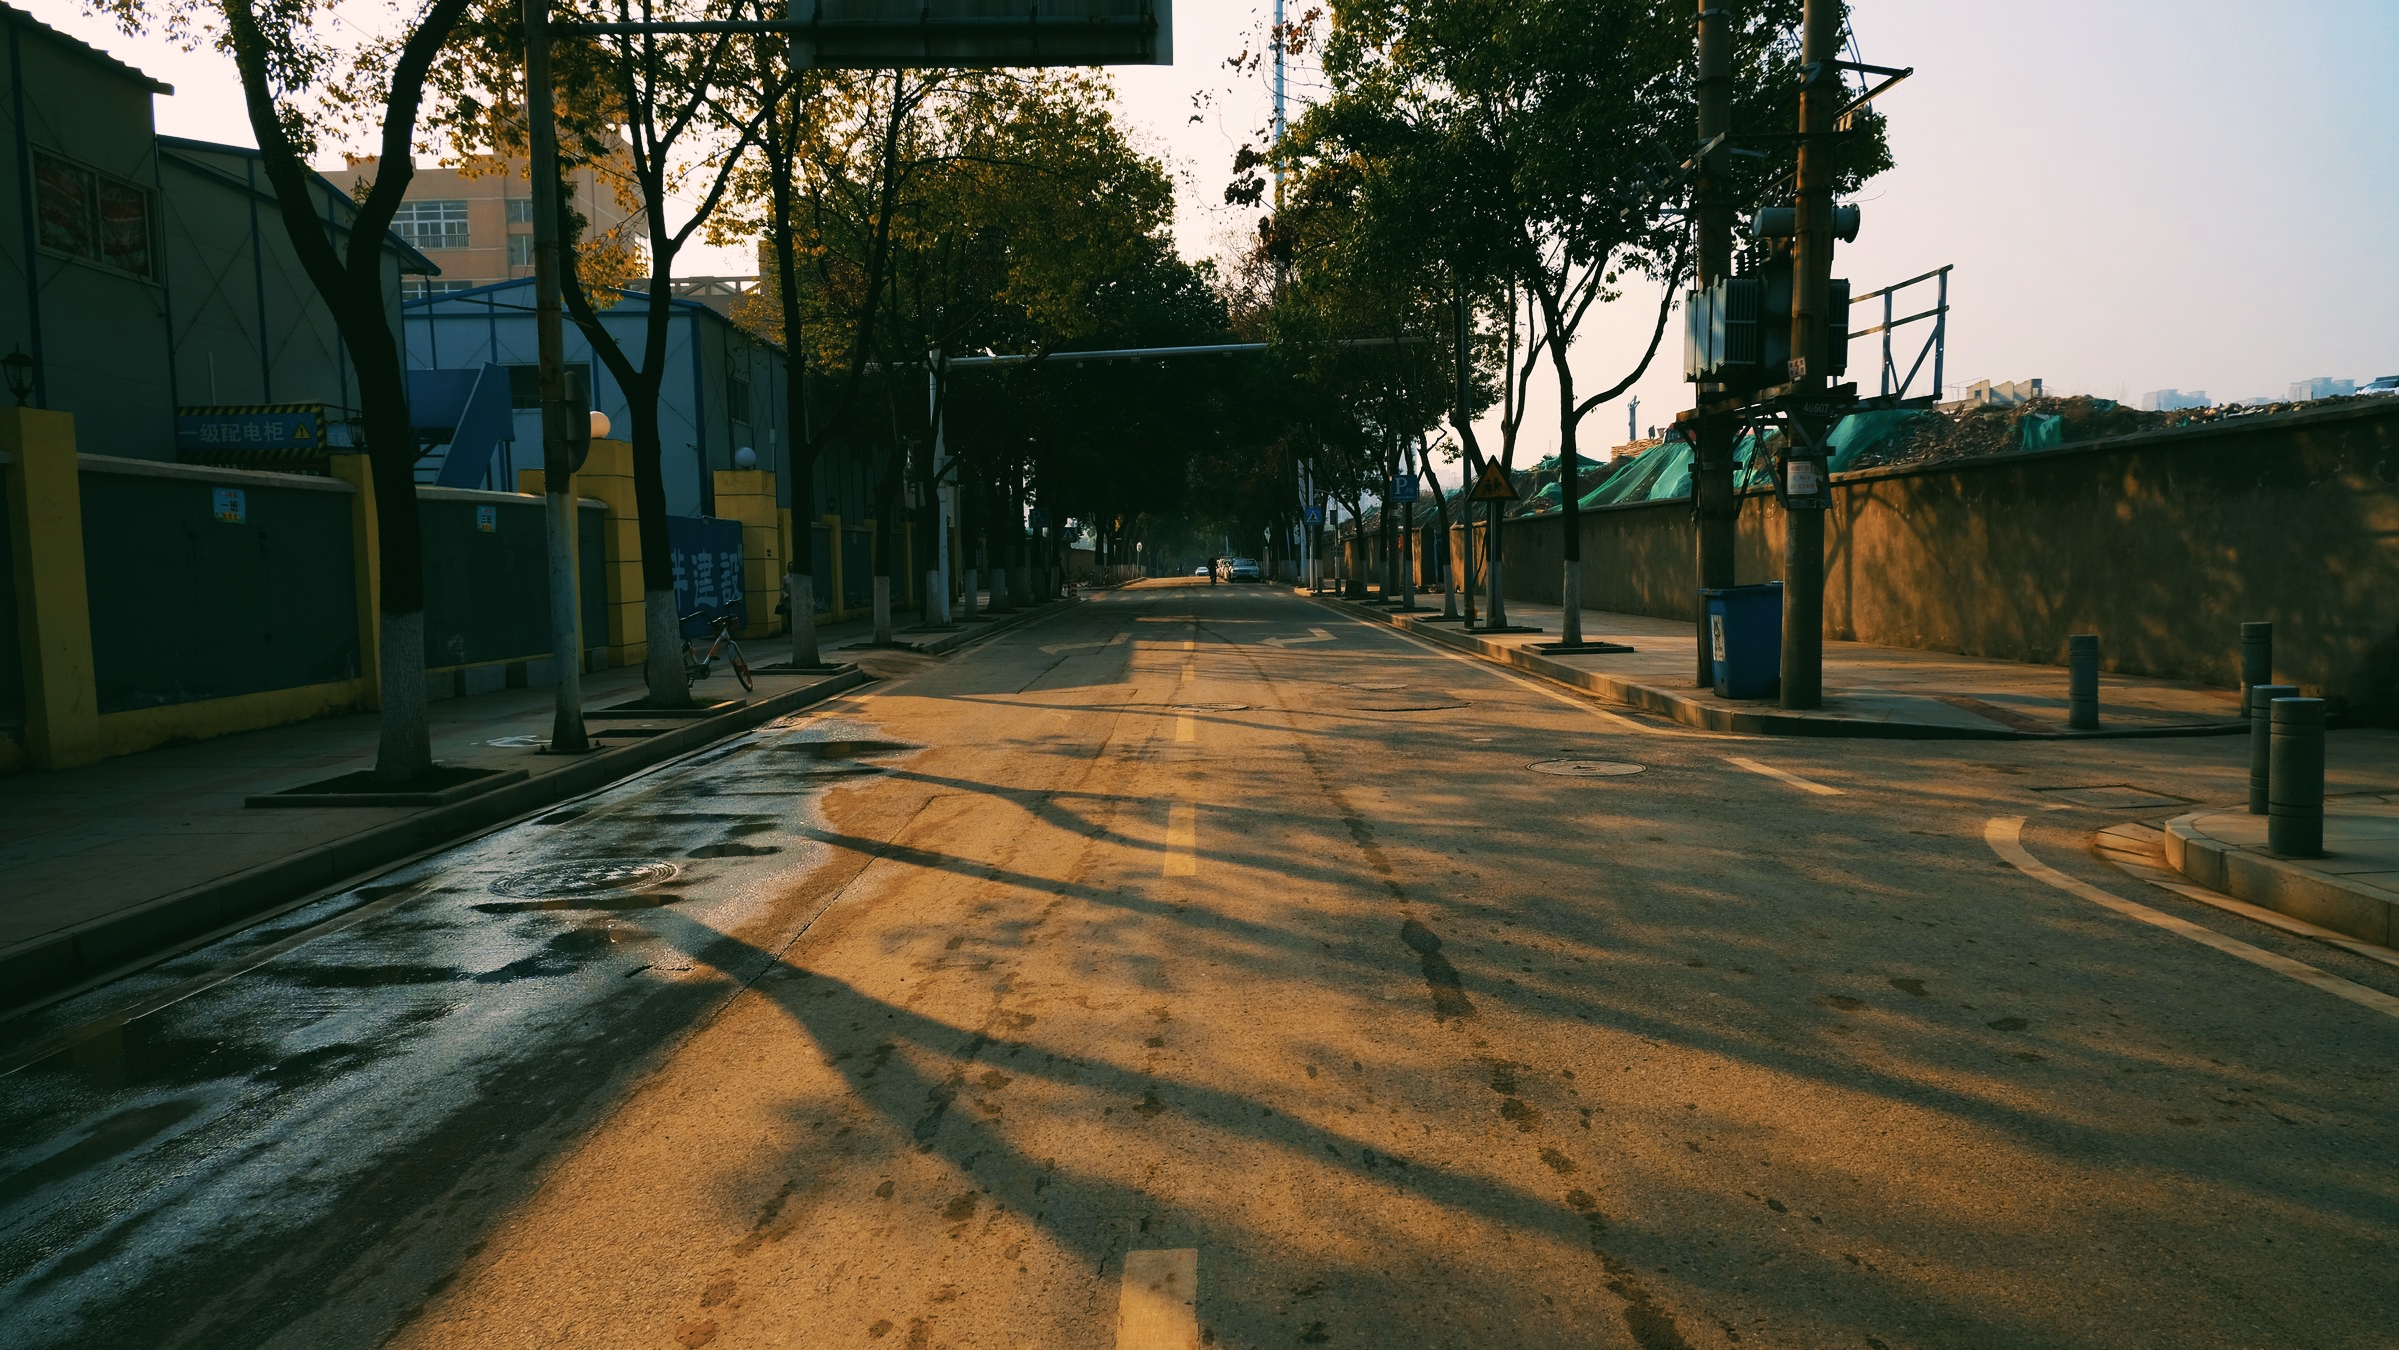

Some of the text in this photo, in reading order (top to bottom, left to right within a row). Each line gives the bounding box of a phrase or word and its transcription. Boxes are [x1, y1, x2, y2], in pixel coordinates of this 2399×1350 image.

[1803, 402, 1829, 414] 40607
[179, 421, 284, 443] 一级配电柜
[1394, 477, 1408, 495] P
[1032, 510, 1041, 523] P
